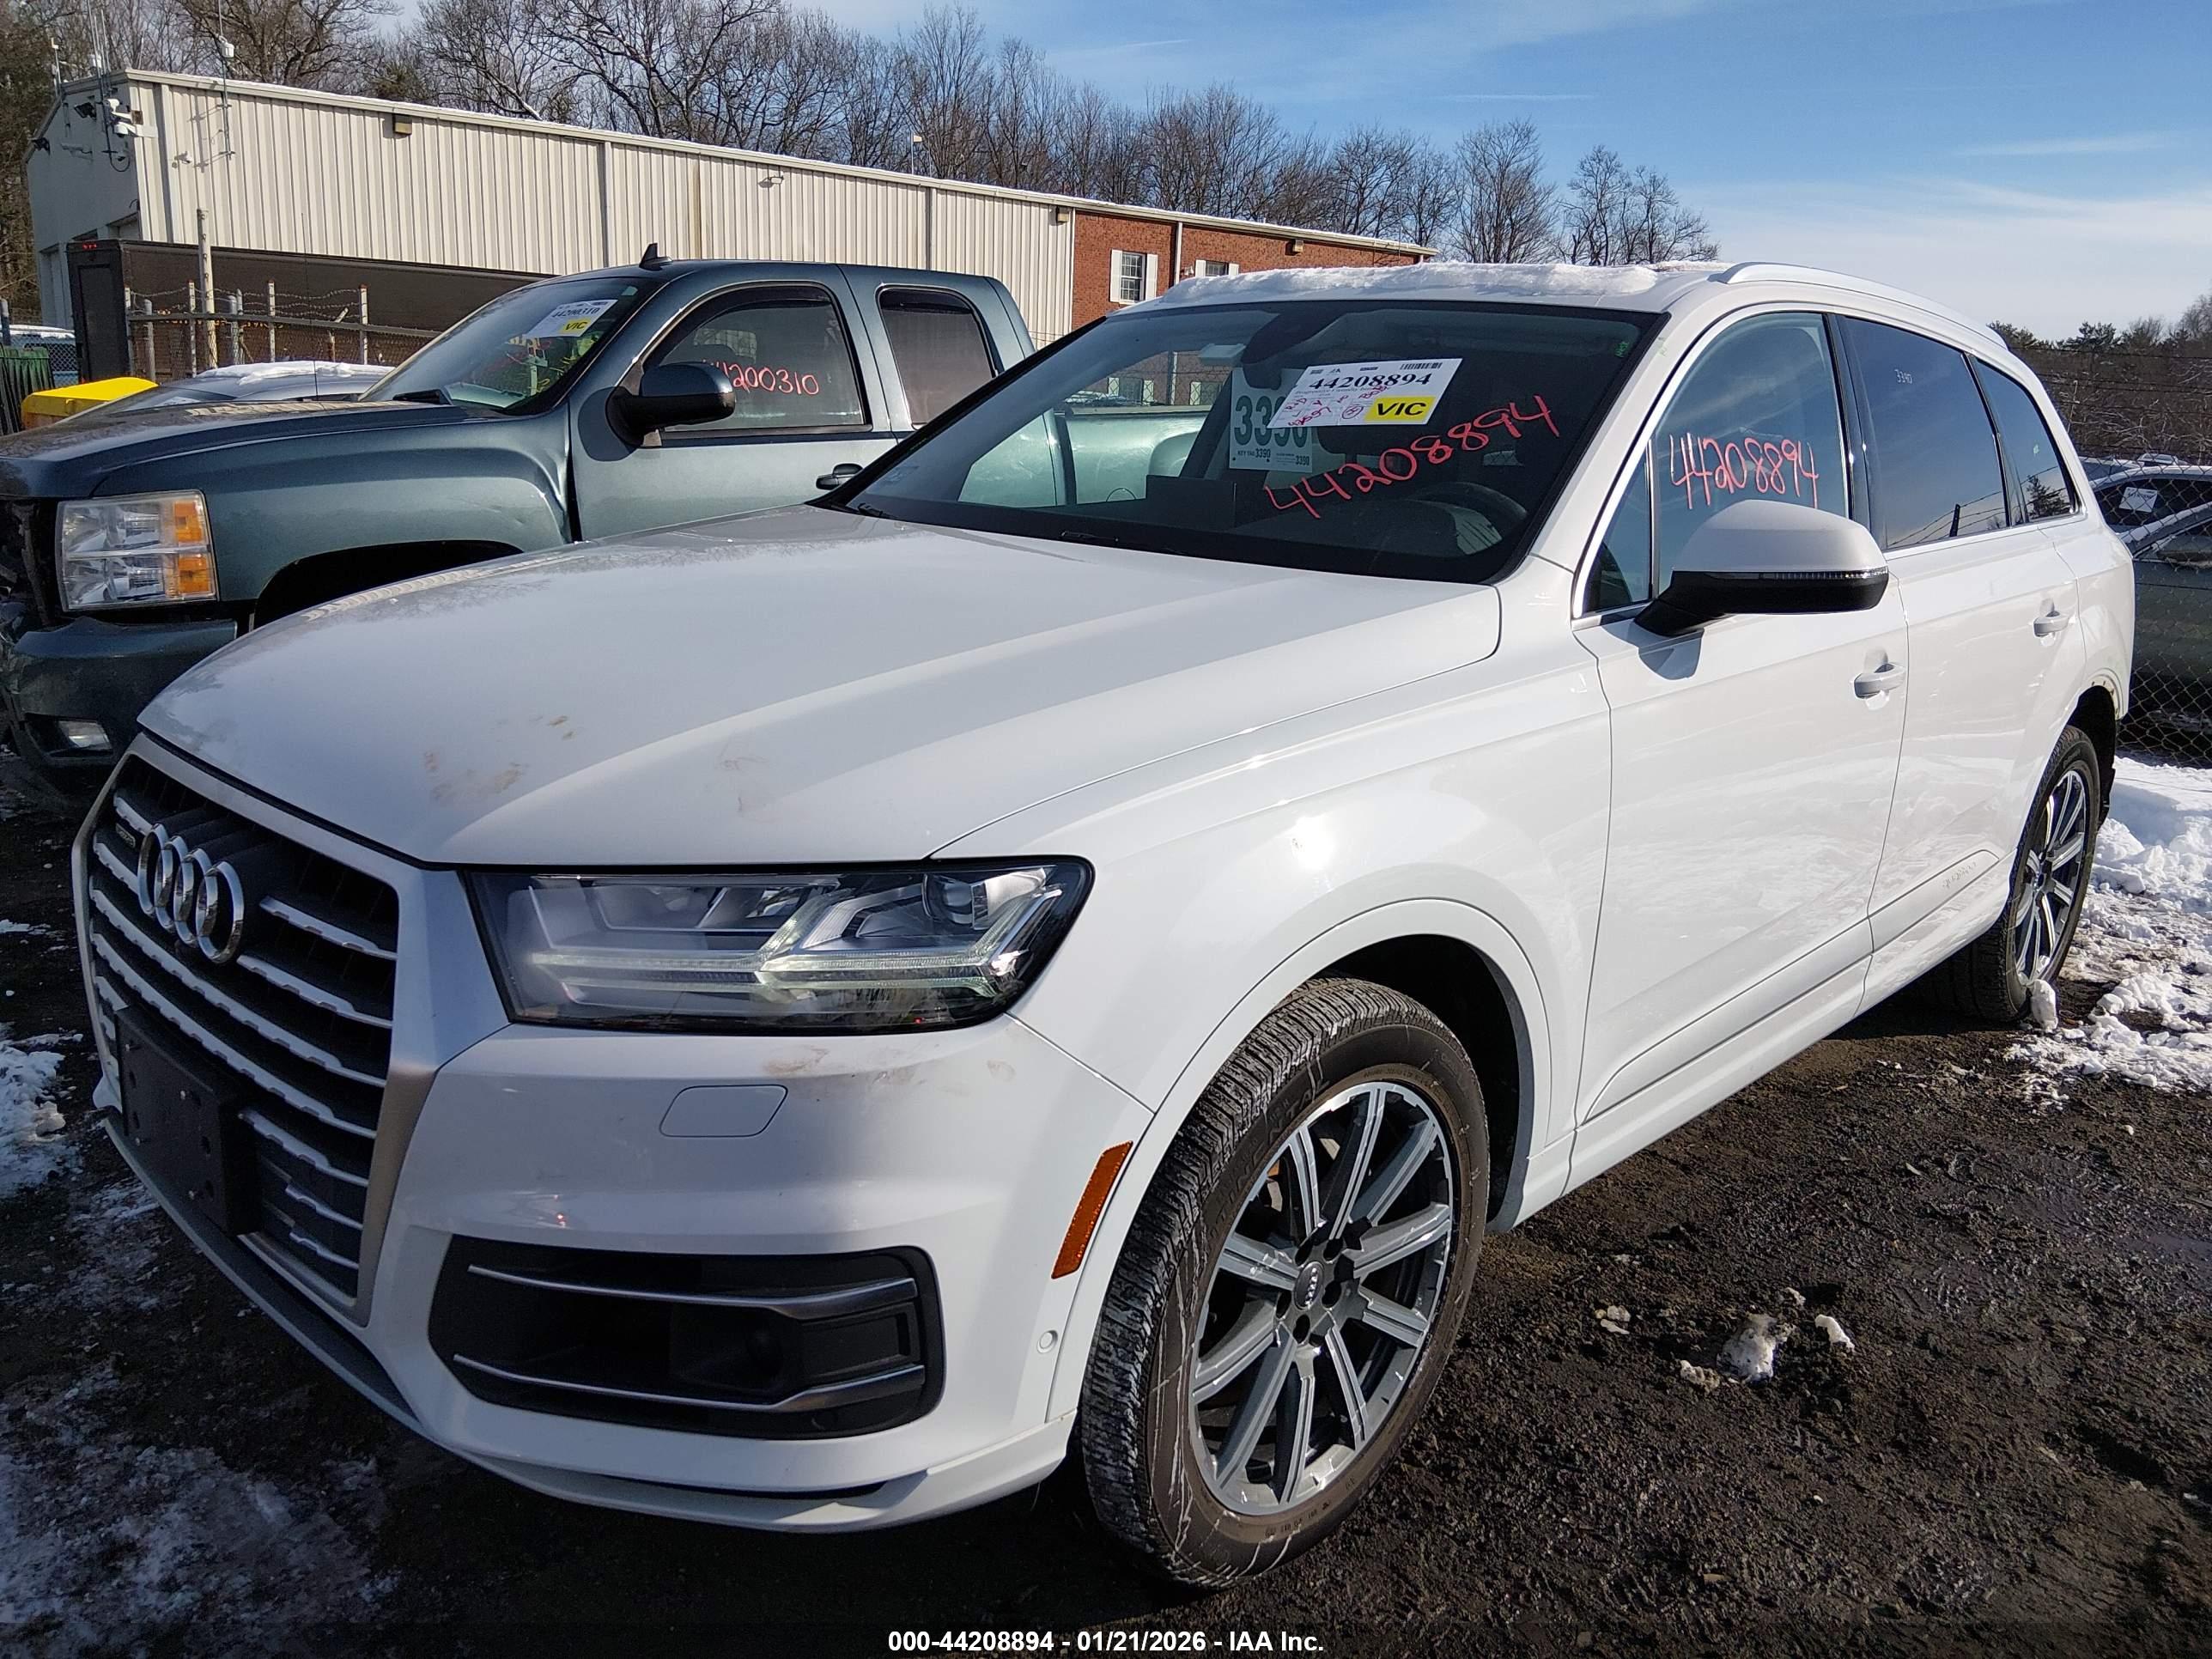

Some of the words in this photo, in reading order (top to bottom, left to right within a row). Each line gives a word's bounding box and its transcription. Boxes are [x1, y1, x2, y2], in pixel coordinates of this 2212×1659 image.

[566, 321, 588, 331] VIC
[702, 359, 819, 394] 200310
[1308, 372, 1433, 389] 44208894
[1376, 402, 1427, 416] VIC
[1255, 447, 1271, 459] 3390
[1264, 393, 1560, 520] 44208894
[1669, 432, 1820, 510] 44208894
